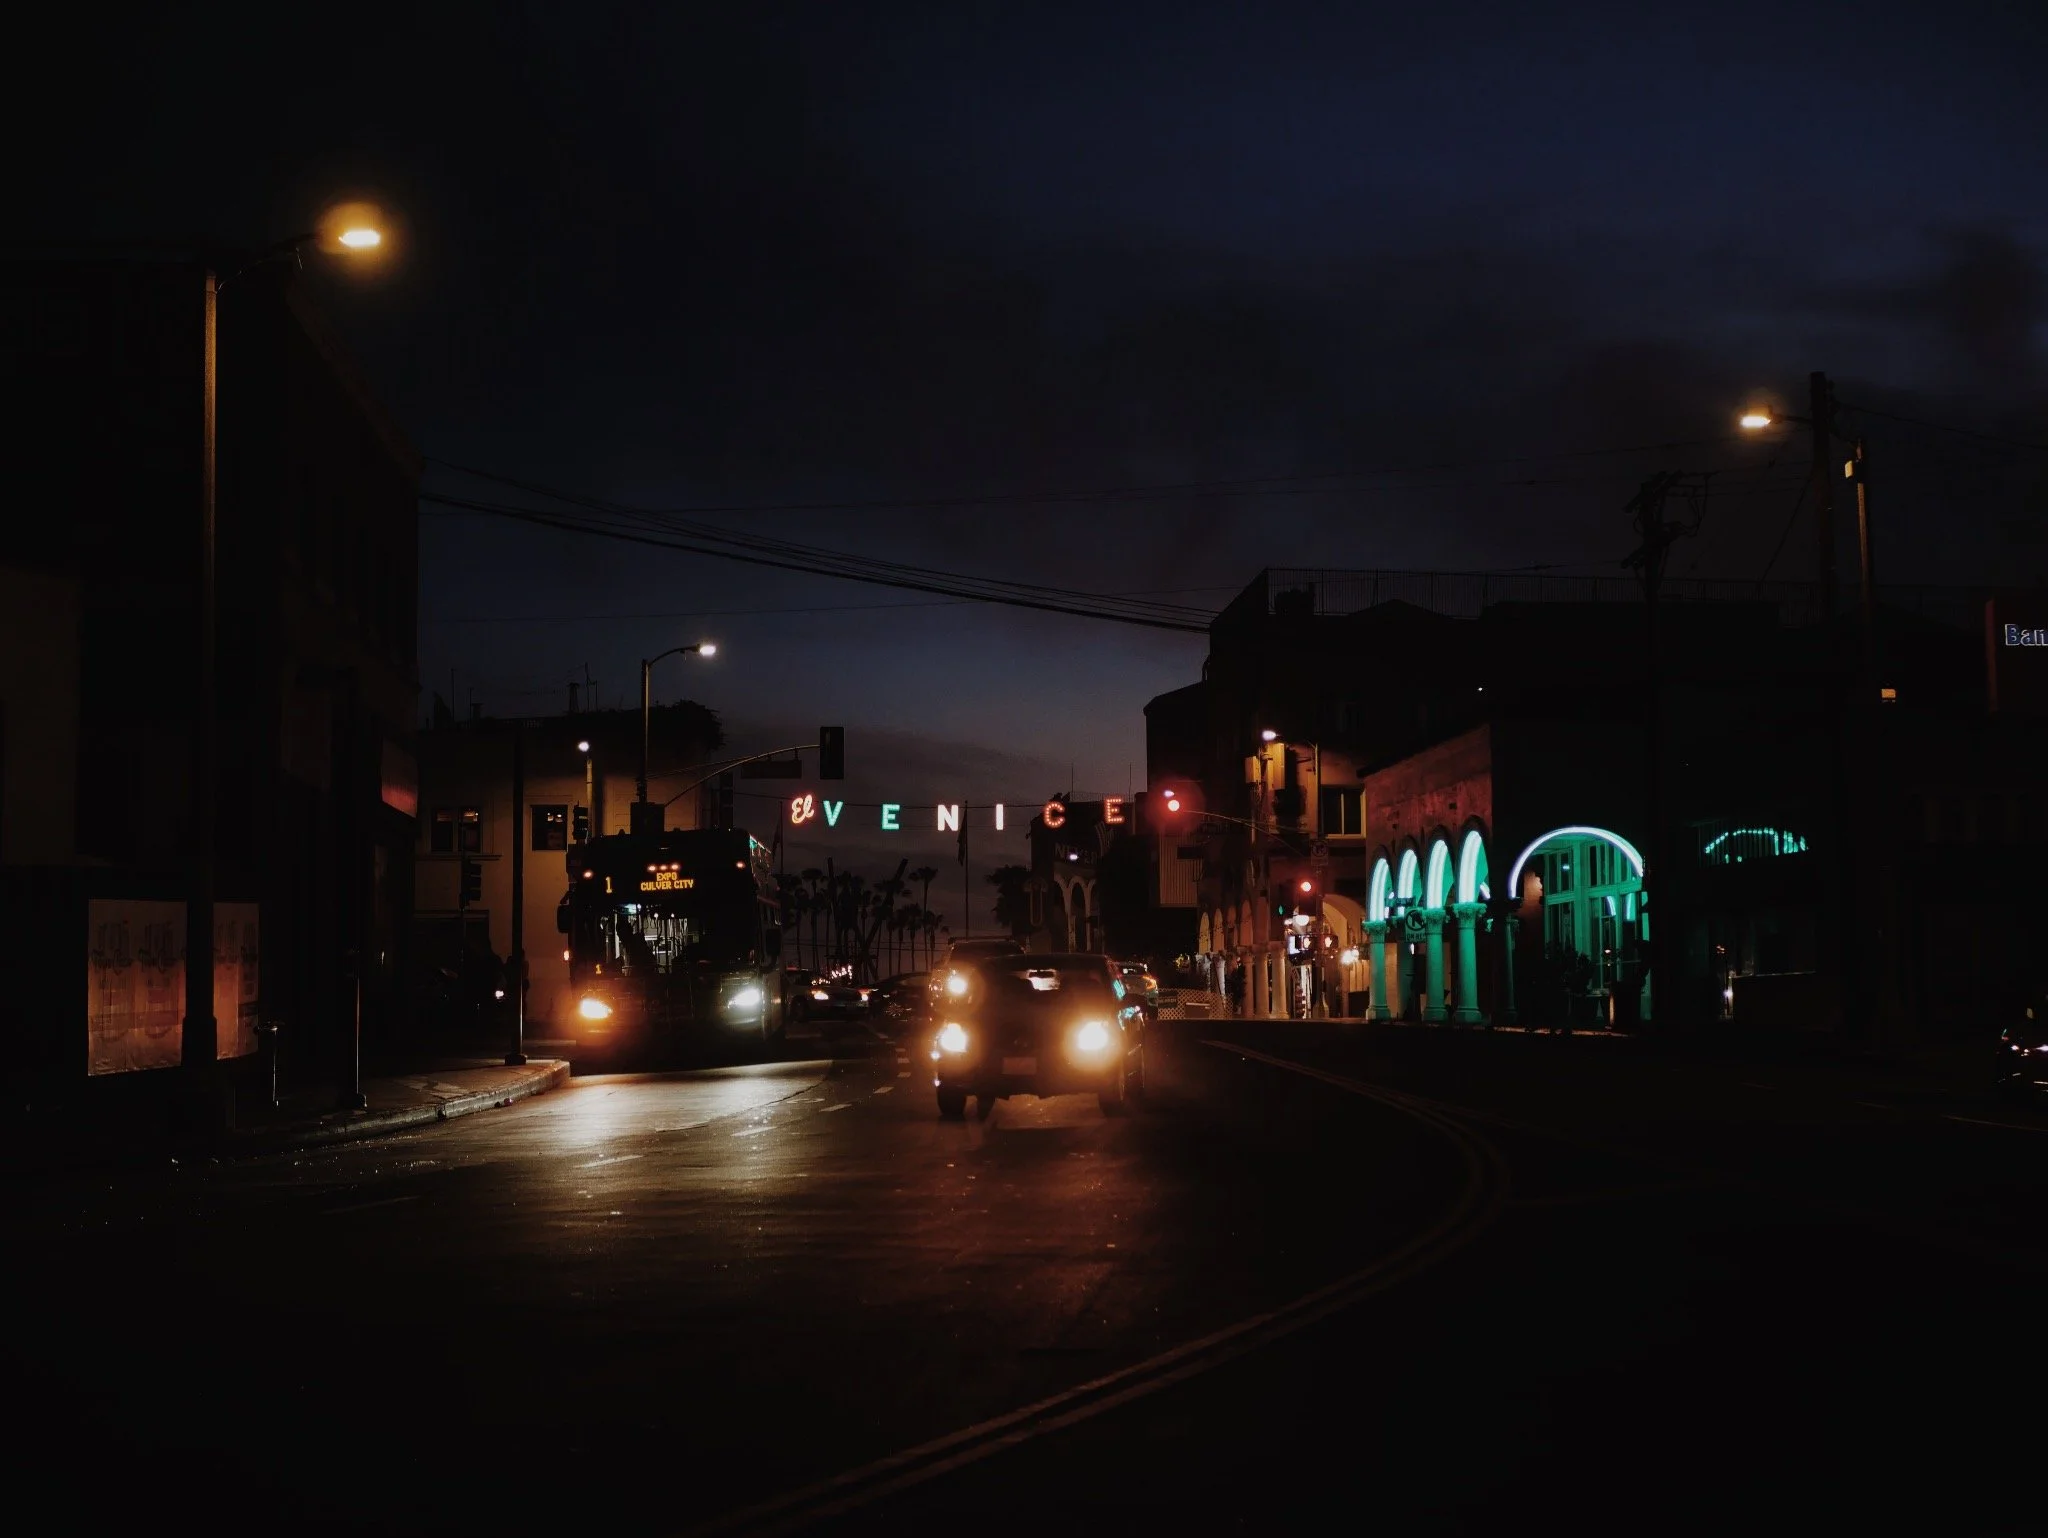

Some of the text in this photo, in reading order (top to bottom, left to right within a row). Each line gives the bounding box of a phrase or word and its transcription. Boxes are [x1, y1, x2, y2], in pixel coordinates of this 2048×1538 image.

[791, 793, 1124, 832] El VENICE
[656, 871, 678, 882] EXPO
[605, 876, 612, 894] 1
[640, 879, 694, 892] CULVER CITY
[595, 963, 603, 975] 1
